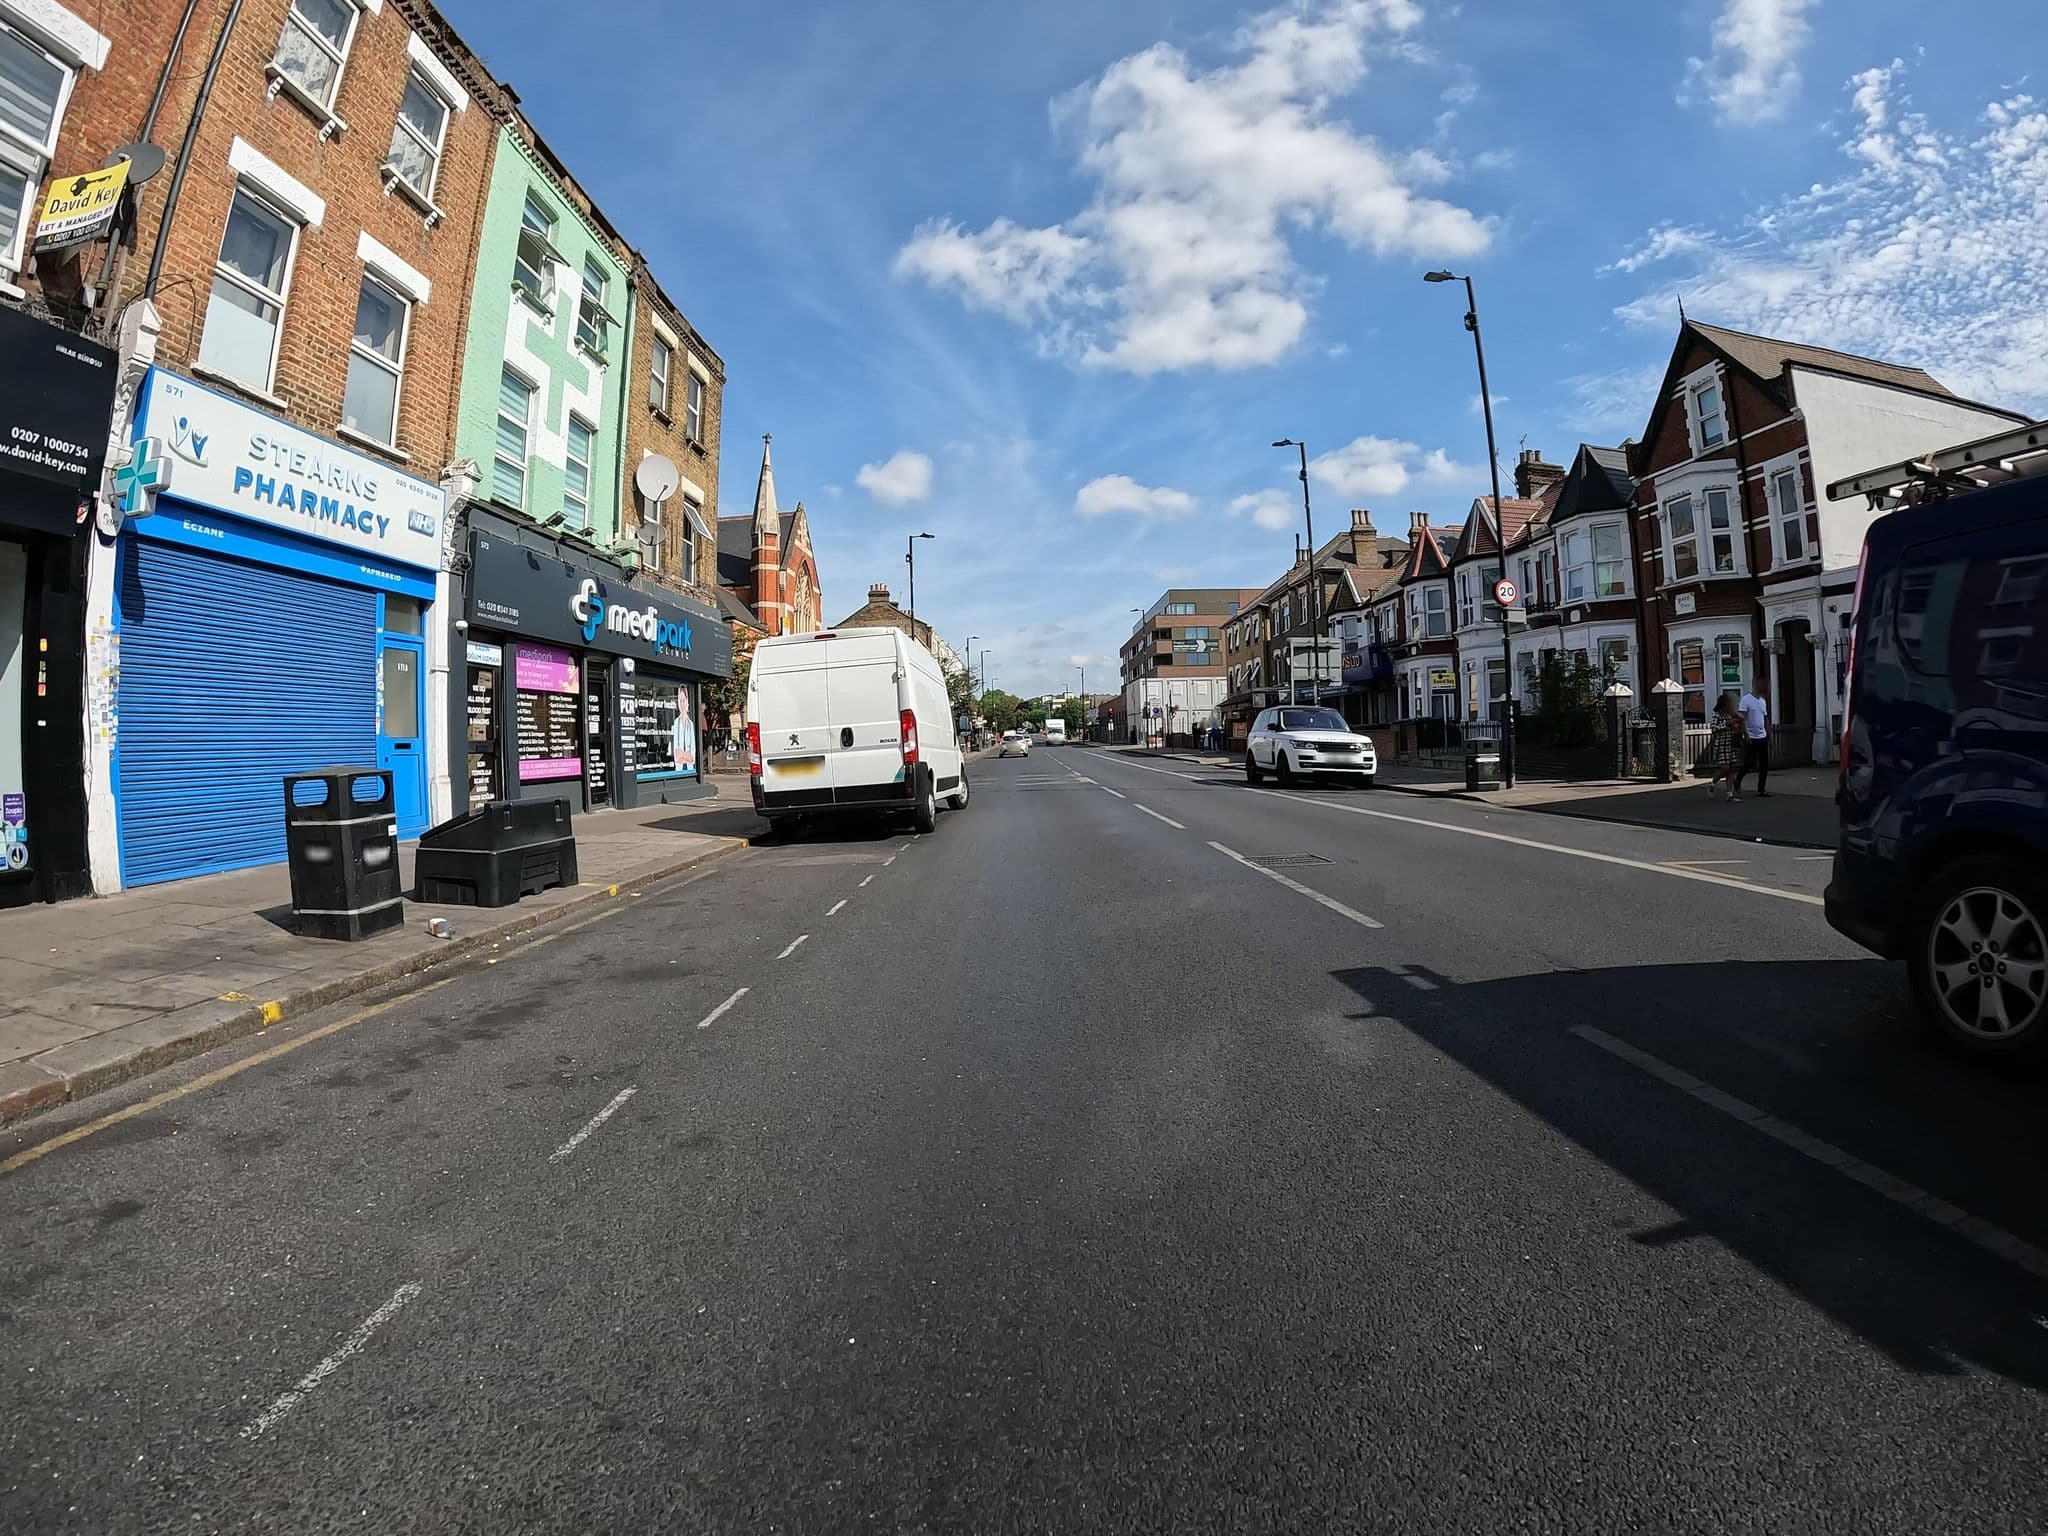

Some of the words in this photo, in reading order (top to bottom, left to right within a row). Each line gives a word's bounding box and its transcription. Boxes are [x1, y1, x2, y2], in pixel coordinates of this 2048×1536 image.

[48, 191, 92, 215] David
[94, 187, 119, 204] Key
[40, 223, 54, 231] LET
[65, 211, 103, 227] MANAGED
[103, 205, 114, 215] BY
[165, 384, 184, 398] 571
[11, 426, 40, 444] 0207
[43, 436, 89, 459] 1000754
[248, 432, 379, 501] STEARNS
[233, 466, 390, 539] PHARMACY
[409, 511, 435, 533] NHS
[1499, 586, 1515, 597] 20
[607, 604, 692, 655] medipark
[519, 648, 553, 662] medipark
[660, 646, 689, 660] CLINIC
[620, 698, 635, 714] PCR
[621, 716, 635, 726] TESTS
